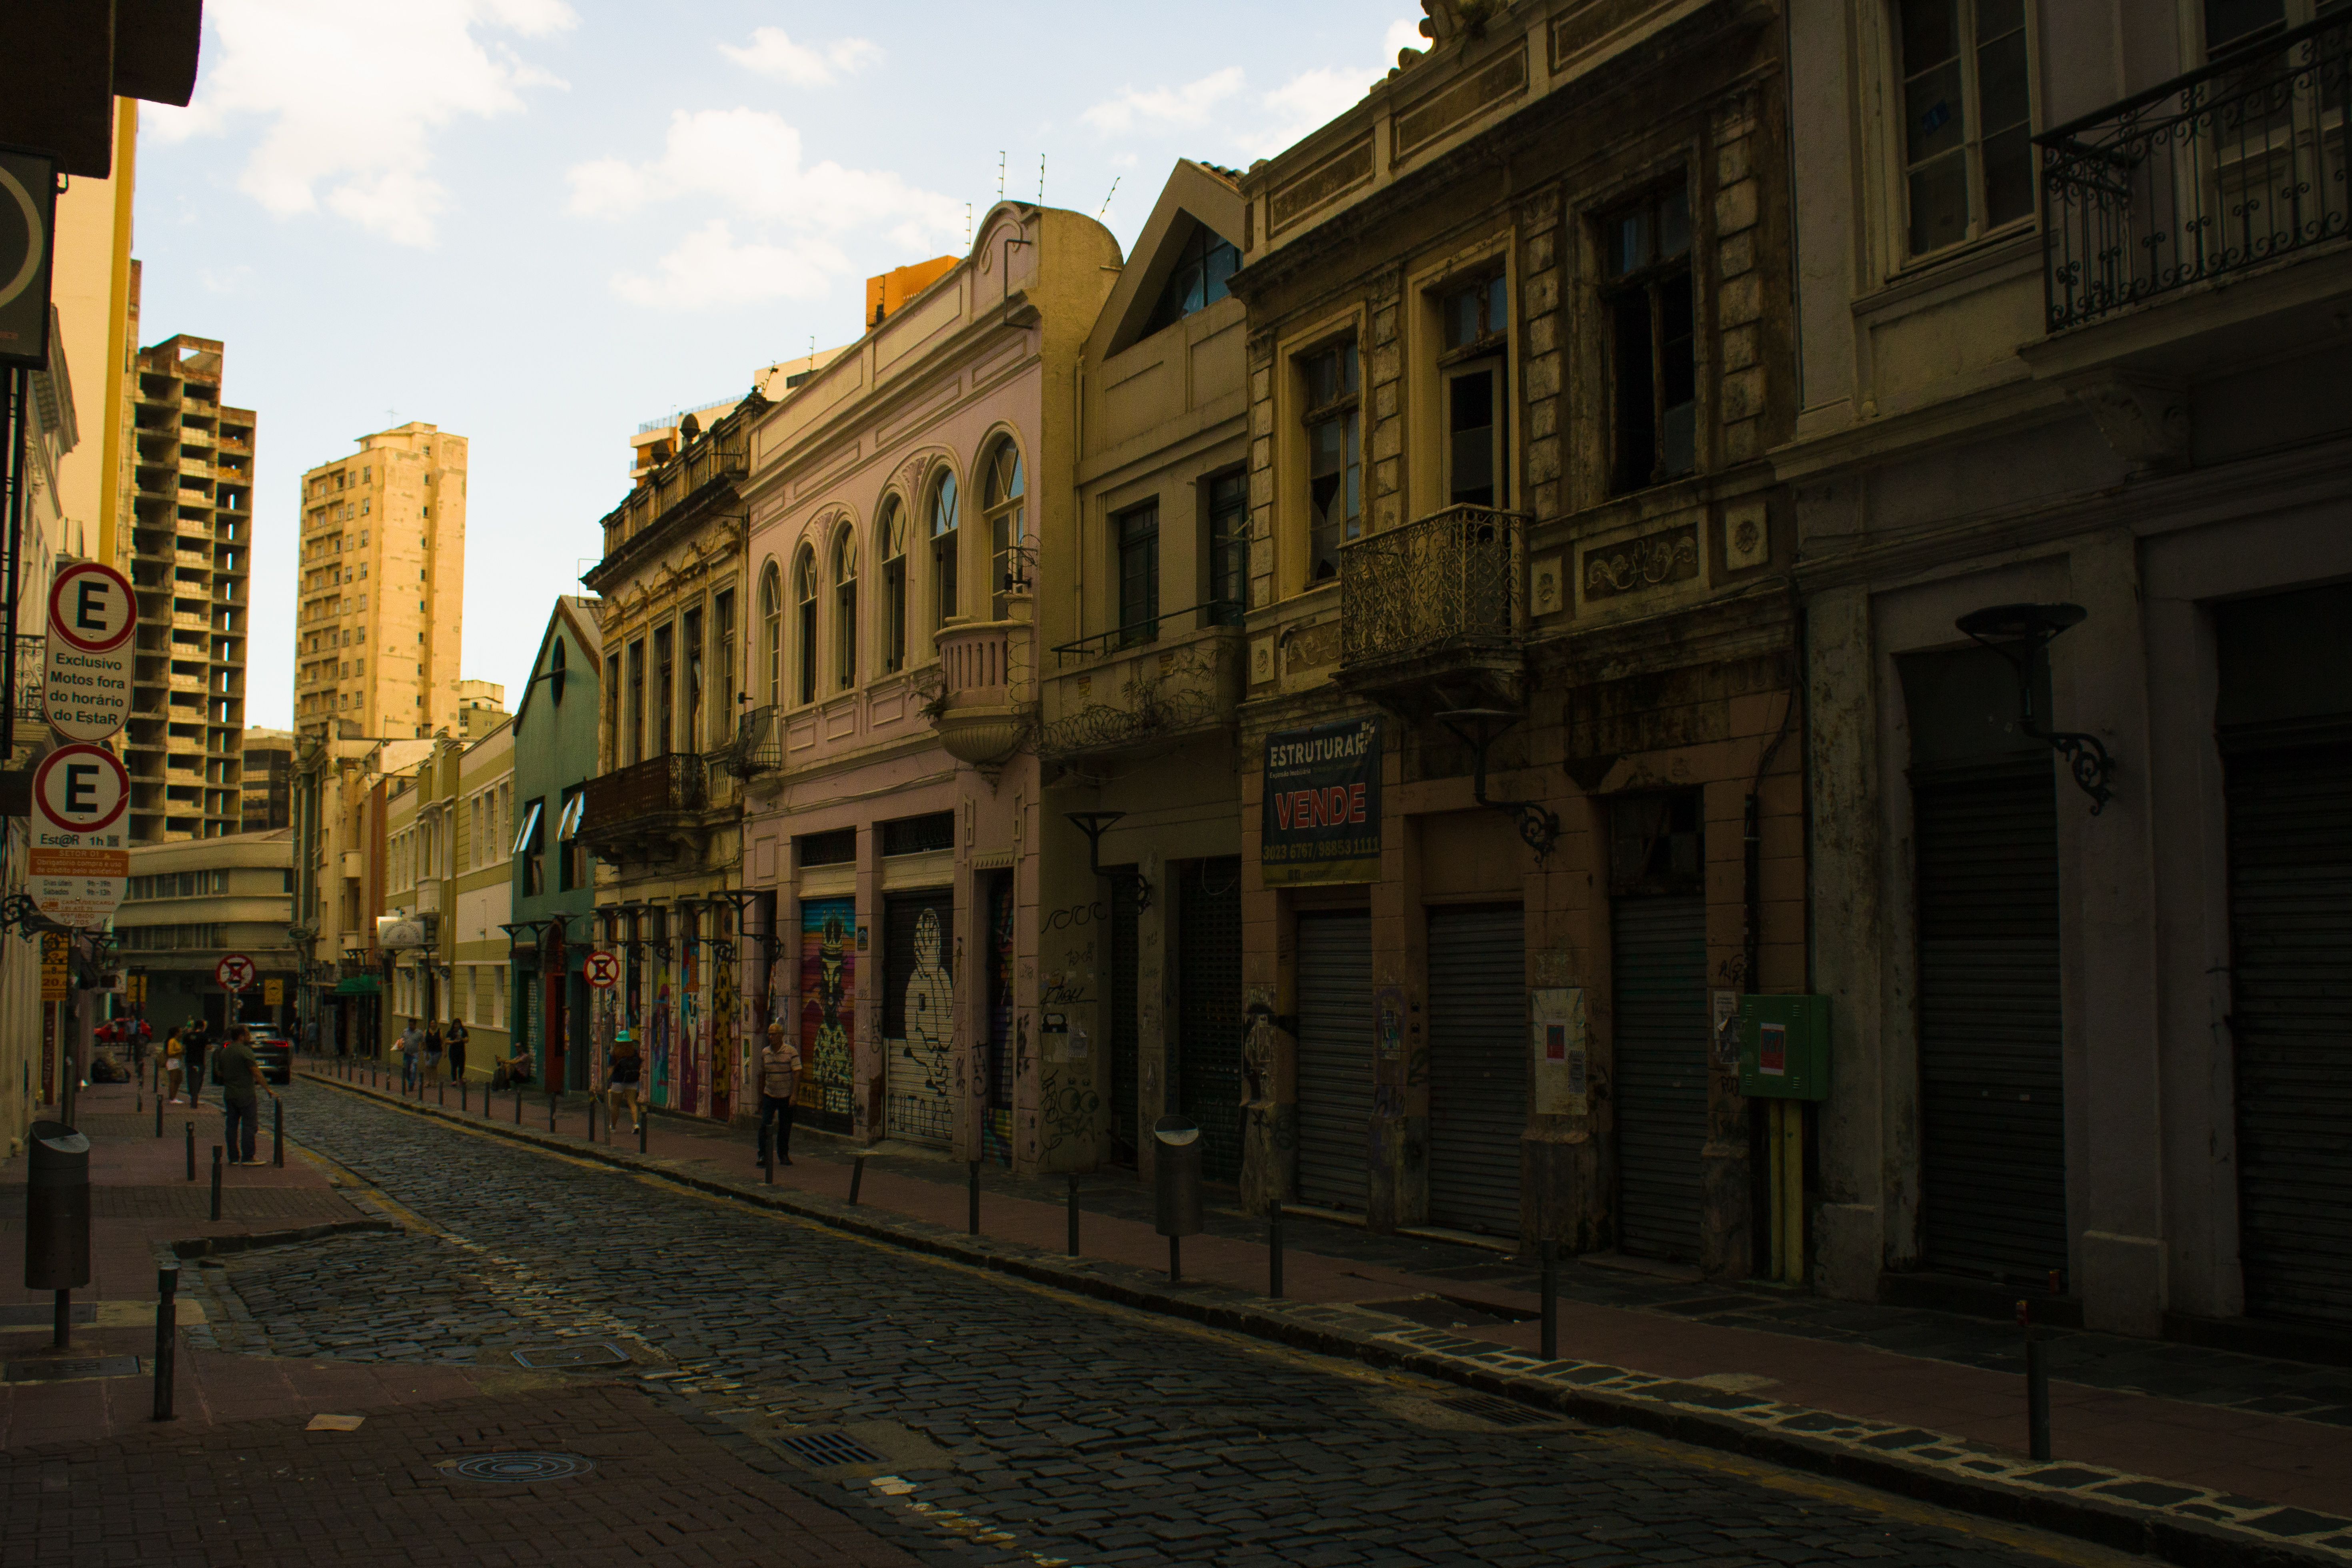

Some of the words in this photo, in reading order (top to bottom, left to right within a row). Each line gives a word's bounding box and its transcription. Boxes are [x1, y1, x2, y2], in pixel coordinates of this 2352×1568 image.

[76, 580, 109, 631] E
[56, 653, 122, 670] Exclusivo
[50, 671, 93, 686] Motos
[97, 675, 124, 689] fora
[50, 690, 68, 701] do
[71, 691, 123, 707] horário
[53, 709, 71, 721] do
[76, 711, 118, 725] EstaR
[65, 763, 100, 813] E
[1275, 782, 1366, 830] VENDE
[40, 833, 80, 847] Est@R
[90, 836, 104, 846] 1h
[1263, 844, 1287, 860] 3023
[1353, 836, 1379, 854] 1111
[36, 859, 76, 867] Obrigatório
